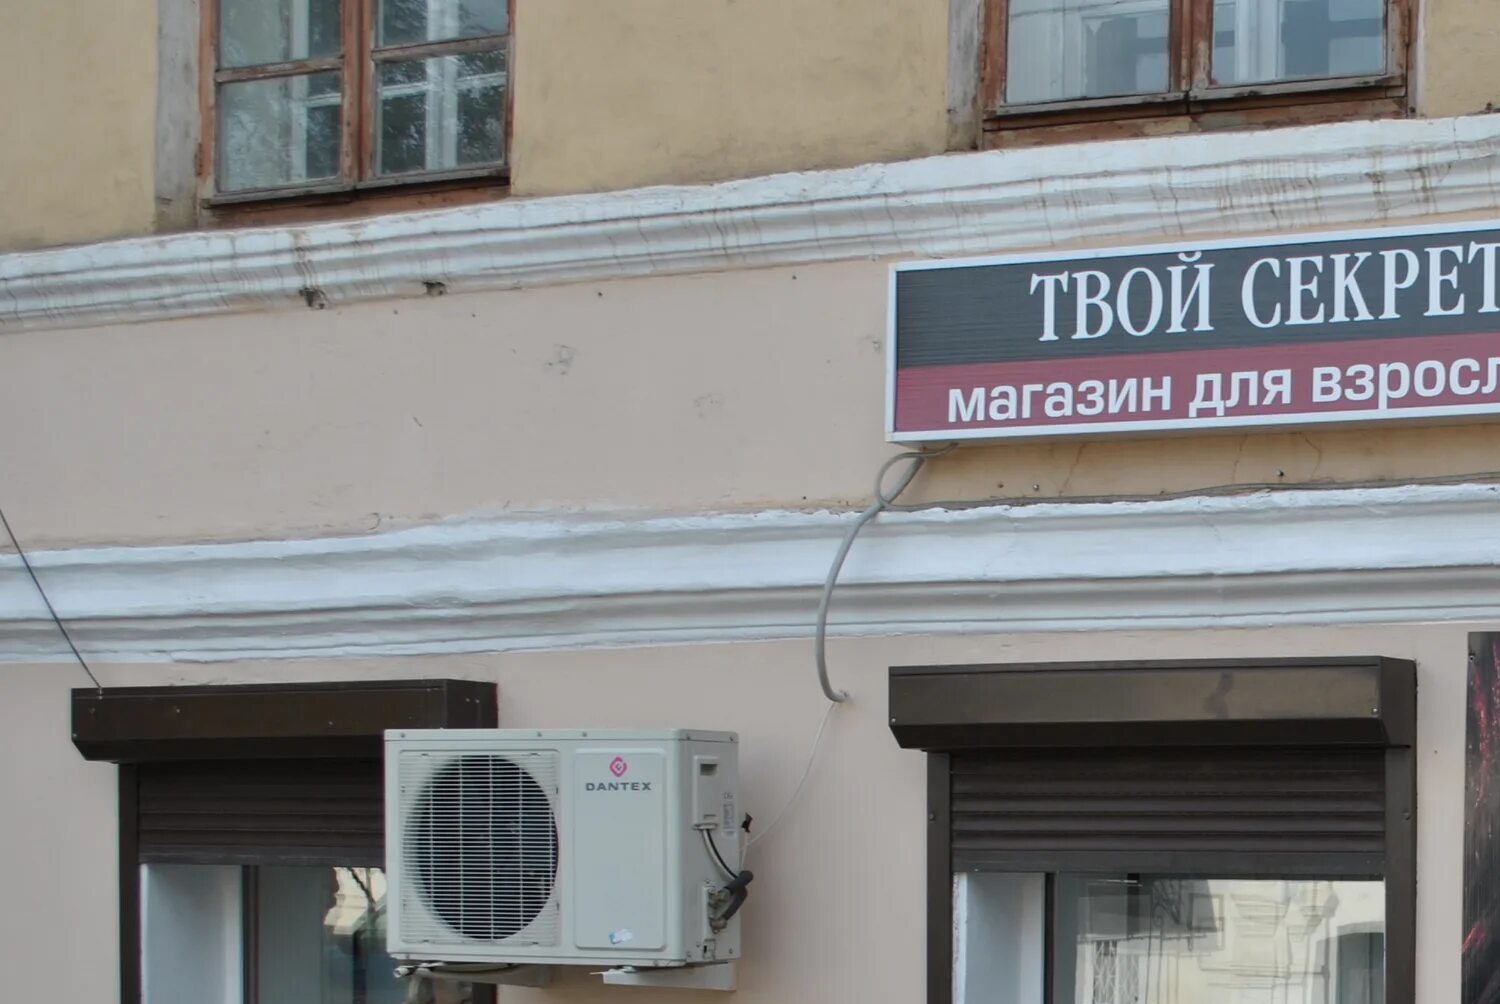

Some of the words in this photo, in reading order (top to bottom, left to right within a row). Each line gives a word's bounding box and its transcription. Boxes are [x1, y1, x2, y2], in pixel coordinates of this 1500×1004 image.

[1029, 251, 1215, 343] ТВОЙ
[947, 374, 1173, 423] магазин
[1188, 368, 1292, 419] для
[585, 782, 652, 792] DANTEX
